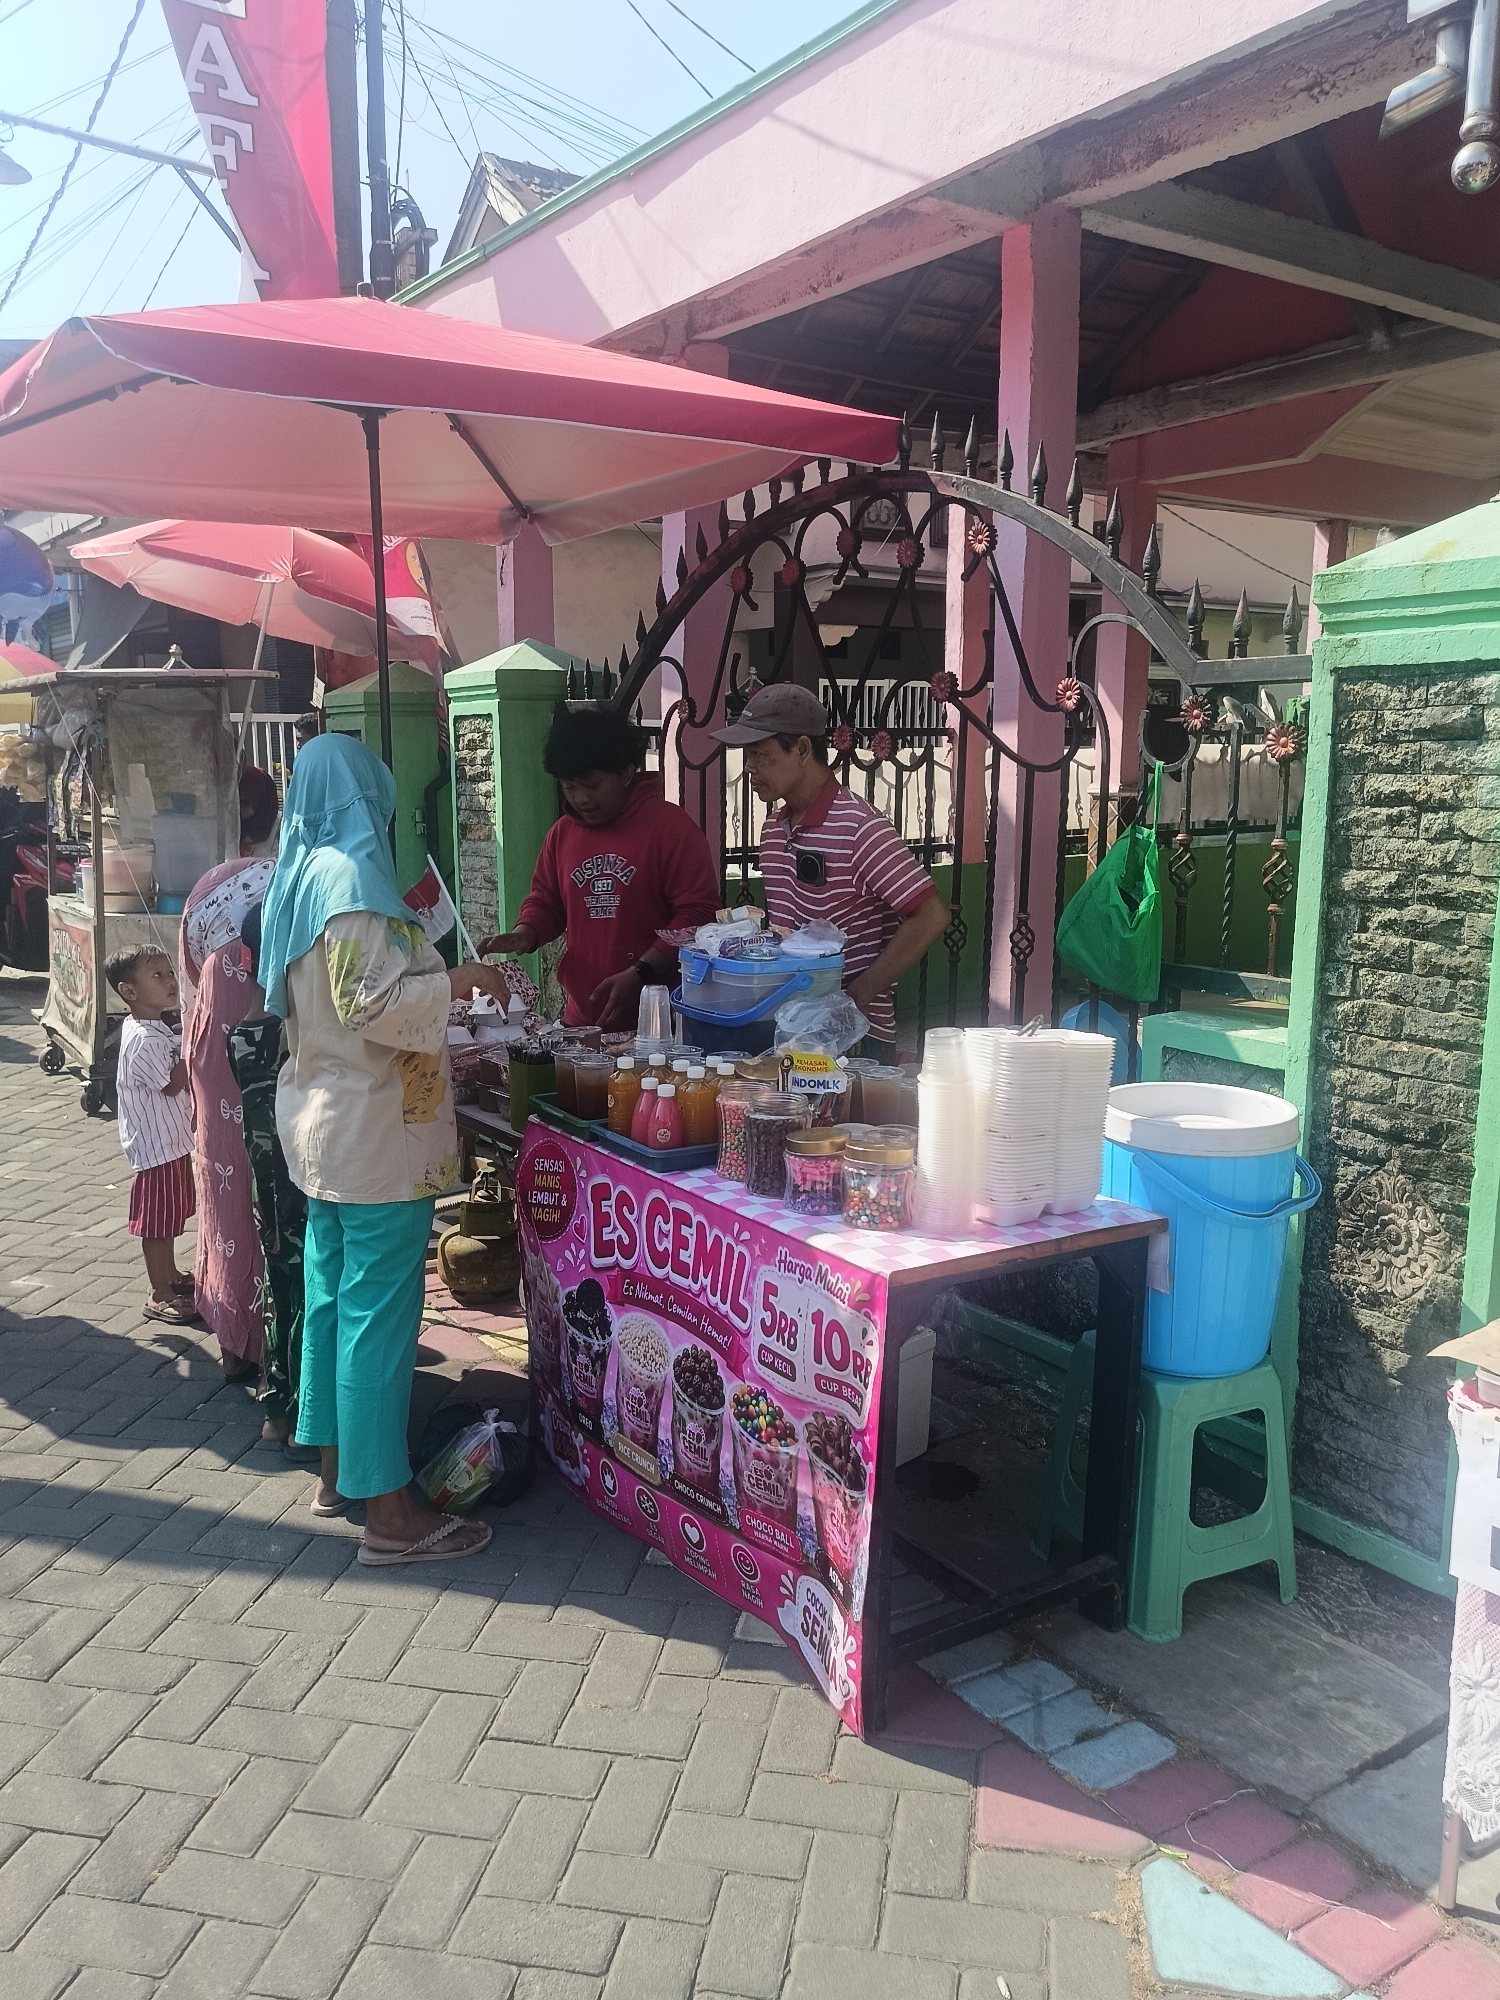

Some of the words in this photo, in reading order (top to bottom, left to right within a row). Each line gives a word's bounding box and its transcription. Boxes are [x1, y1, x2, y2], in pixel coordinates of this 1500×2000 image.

[795, 1065, 829, 1073] EKONOMIS
[534, 1158, 565, 1173] SENSASI
[534, 1175, 562, 1191] MANIS,
[528, 1191, 560, 1206] LEMBUT
[561, 1195, 568, 1207] &
[531, 1206, 561, 1223] NAGIH!
[589, 1181, 639, 1262] ES
[644, 1196, 750, 1326] CEMIL
[777, 1249, 813, 1284] Harga
[815, 1263, 850, 1305] Mulai
[622, 1279, 633, 1296] Es
[635, 1281, 665, 1309] Nikmat,
[667, 1294, 698, 1326] Cemilan
[699, 1313, 733, 1351] Hemat!
[761, 1350, 773, 1363] CUP
[774, 1354, 793, 1377] KECIL
[820, 1379, 839, 1393] CUP
[688, 1430, 695, 1440] ES
[618, 1441, 631, 1458] RICE
[631, 1449, 655, 1475] CRUNCH
[682, 1436, 709, 1461] CEMIL
[753, 1466, 764, 1479] ES
[674, 1479, 695, 1499] CHOCO
[695, 1492, 722, 1515] CRUNCH
[747, 1473, 783, 1499] CEMIL
[745, 1514, 773, 1536] CHOCO
[775, 1528, 795, 1549] BALL
[741, 1580, 760, 1597] RASA
[806, 1587, 828, 1625] COCOK
[800, 1604, 839, 1693] SEMUA
